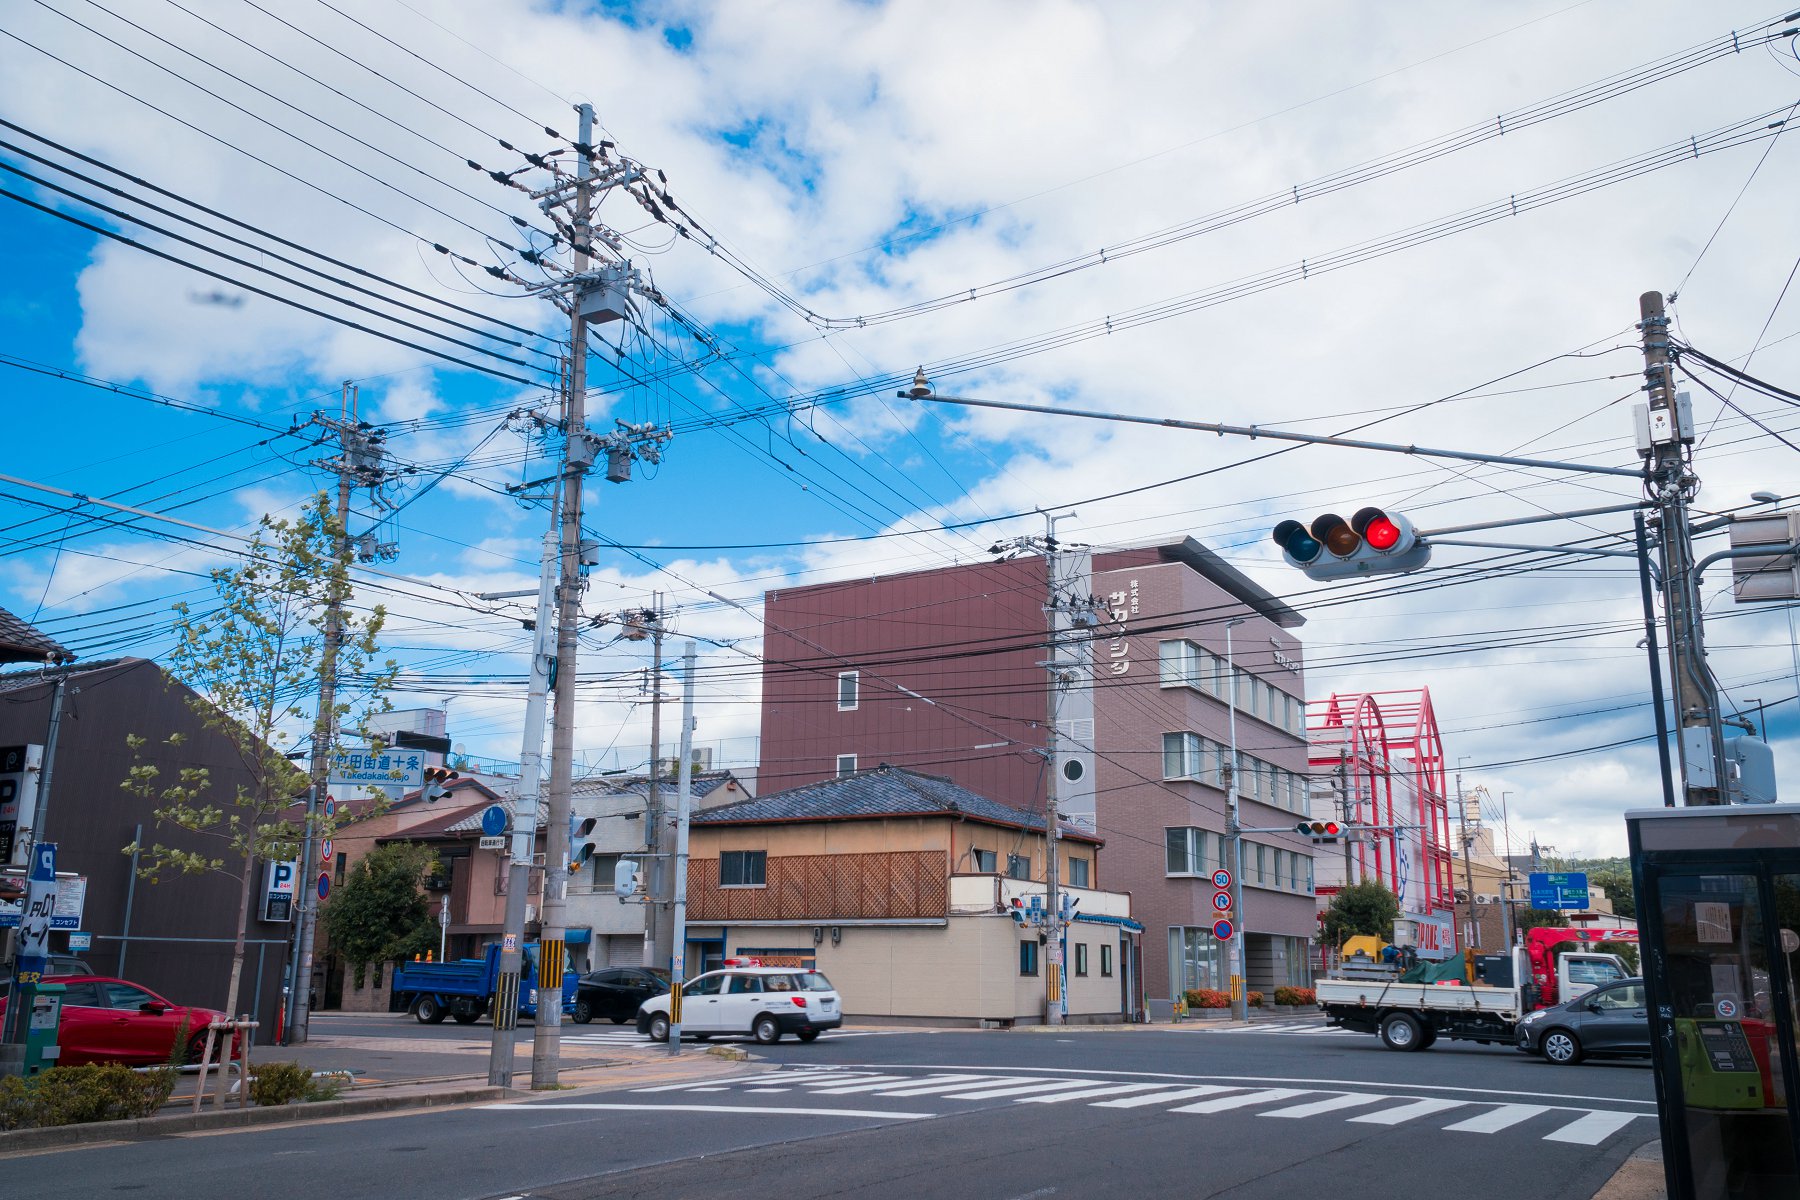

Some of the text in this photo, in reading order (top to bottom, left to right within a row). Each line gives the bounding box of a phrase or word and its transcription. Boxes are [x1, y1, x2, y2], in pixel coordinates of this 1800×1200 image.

[1130, 579, 1139, 614] 株式会社
[1109, 591, 1129, 675] サカノシタ
[335, 753, 420, 771] 竹田街道十条
[273, 865, 291, 889] P
[1216, 874, 1228, 885] 50
